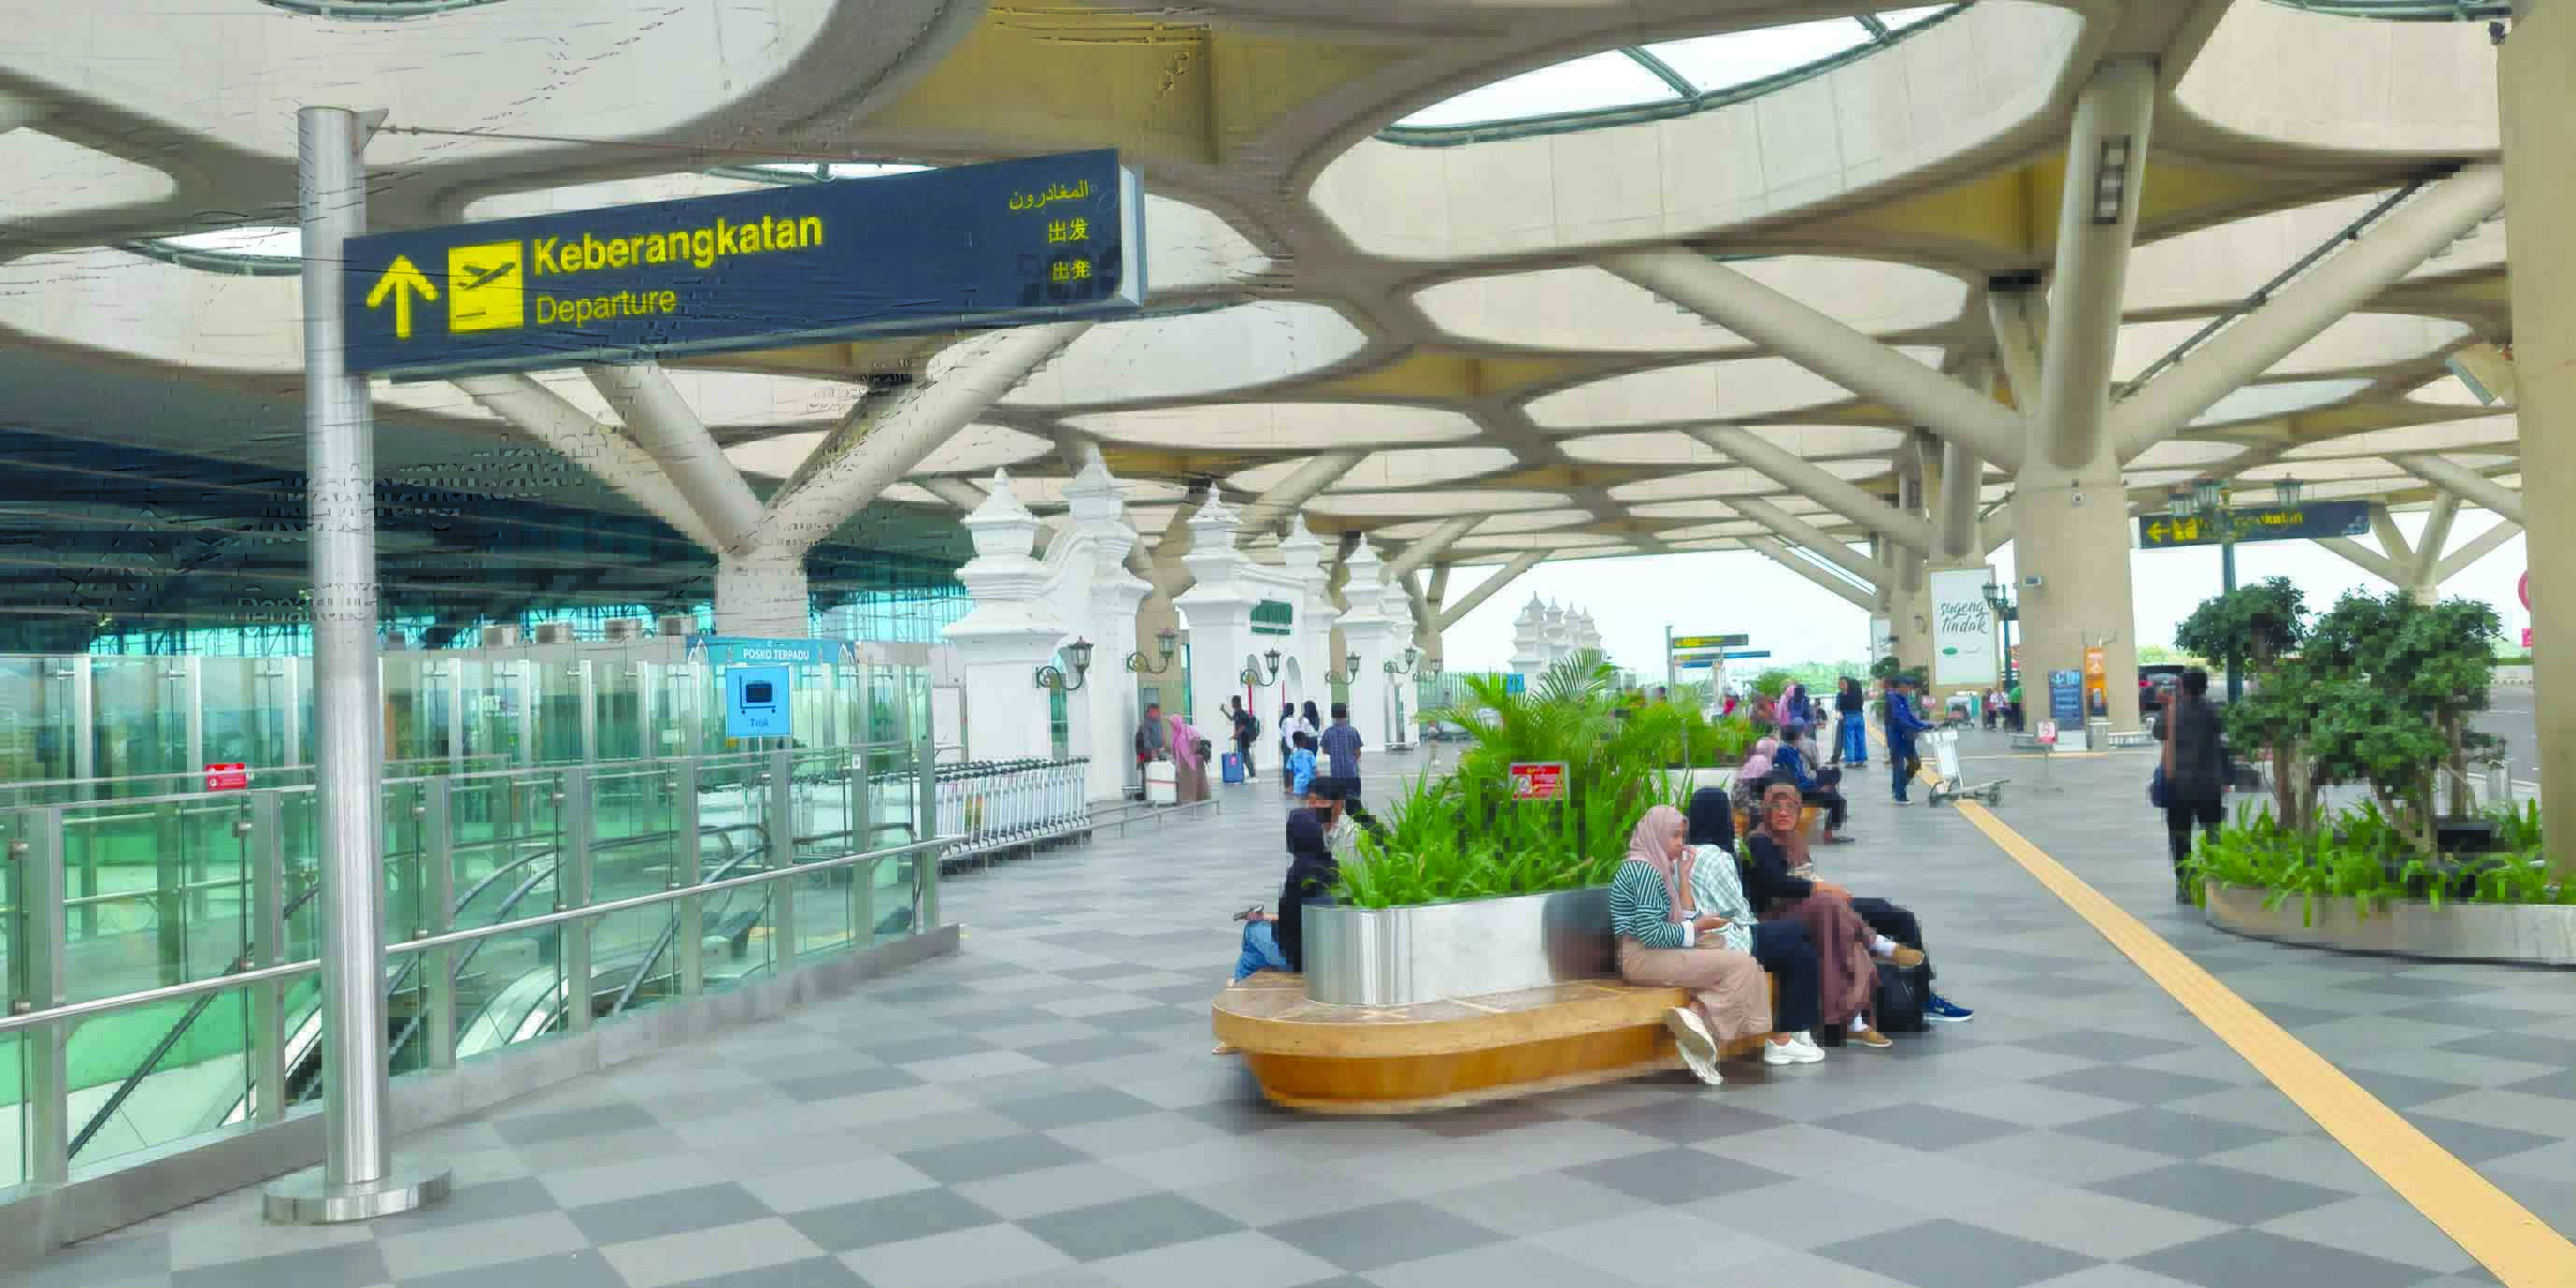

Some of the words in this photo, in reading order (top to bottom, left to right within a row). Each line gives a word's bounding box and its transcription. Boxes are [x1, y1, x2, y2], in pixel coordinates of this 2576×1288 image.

[1009, 179, 1090, 210] المغادرون
[1047, 217, 1090, 243] 出发
[533, 214, 823, 277] Keberangkatan
[536, 290, 678, 327] Departure
[1940, 601, 1990, 619] sugeng
[743, 649, 772, 659] POSKO
[774, 650, 809, 660] TERPADU
